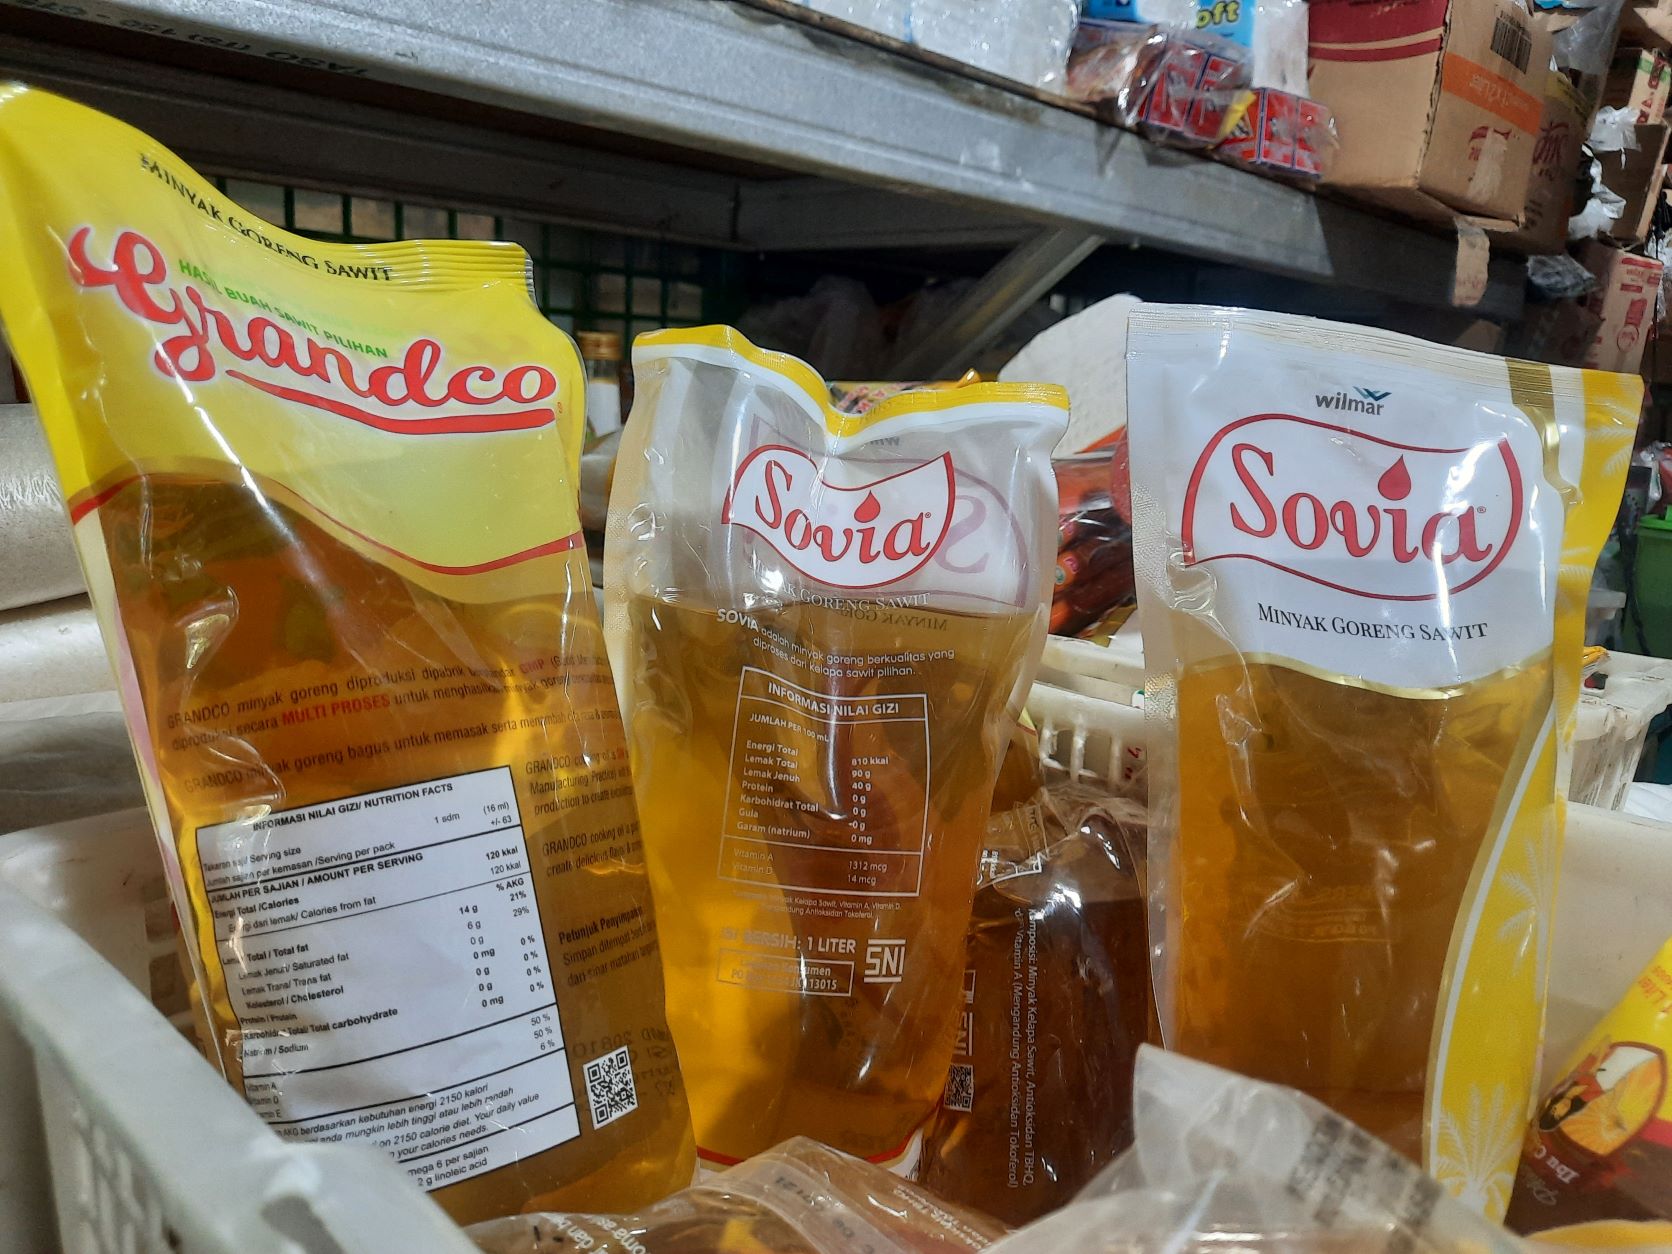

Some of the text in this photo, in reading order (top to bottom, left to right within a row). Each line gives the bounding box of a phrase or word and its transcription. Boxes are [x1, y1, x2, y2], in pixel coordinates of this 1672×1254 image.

[1196, 1, 1239, 28] oft
[140, 153, 394, 281] MINYAK GORENG SAWIT
[67, 227, 557, 406] Grandco
[178, 259, 389, 359] HASIL BUAH SAWIT PILIHAN
[1315, 391, 1384, 416] wilmar
[755, 460, 931, 564] Sovia
[1230, 444, 1493, 564] Sovia
[800, 589, 930, 611] GORENG SAWIT
[1258, 603, 1489, 641] MINYAK GORENG SAWIT
[716, 608, 955, 666] SOVIA adalah minyak goreng berkualitas yang
[753, 637, 916, 679] diproses dari sawit pilihan.
[167, 702, 230, 729] GRANDCO
[237, 692, 282, 715] minyak
[290, 681, 338, 704] goreng
[346, 668, 416, 693] diproduksi
[421, 666, 463, 683] dipabrik
[768, 681, 899, 716] INFORMASI NILAI GIZI
[236, 688, 430, 737] secara MULTI PROSES untuk
[750, 712, 787, 729] JUMLAH
[184, 719, 518, 795] GRANDCO goreng bagus untuk memasak serta
[746, 739, 799, 756] Energi Total
[526, 756, 571, 775] GRANDCO
[745, 753, 799, 769] Lemak Total
[869, 756, 889, 765] kkal
[530, 774, 589, 796] Manufacturing
[743, 767, 801, 784] Lemak Jenuh
[741, 780, 774, 793] Protein
[252, 783, 453, 832] INFORMASI NILAI GIZI/ NUTRITION FACTS
[483, 804, 496, 816] (16
[534, 796, 580, 817] production
[738, 807, 759, 819] Gula
[740, 793, 819, 813] Karbohidrat Total
[442, 813, 460, 824] sdm
[502, 815, 512, 825] 63
[737, 821, 812, 839] Garam (natrium)
[283, 846, 301, 858] size
[485, 845, 518, 861] 120 kkal
[542, 833, 587, 857] GRANDCO
[734, 847, 765, 861] Vitamin
[272, 841, 396, 875] kemasan /Serving per pack
[490, 860, 522, 875] 120 kkal
[575, 849, 609, 870] delicious
[849, 860, 888, 873] 1312 mcg
[242, 852, 424, 898] PER SAJIAN AMOUNT PER SERVING
[506, 877, 525, 890] AKG
[858, 876, 877, 886] mcg
[258, 896, 300, 913] /Calories
[509, 890, 527, 902] 21%
[270, 895, 377, 928] lemak/ Calories from fat
[512, 906, 530, 918] 29%
[805, 906, 843, 918] Antioksidan
[558, 920, 600, 945] Petunjuk
[272, 943, 309, 959] Total fat
[481, 948, 496, 960] mg
[563, 944, 598, 967] Simpan
[599, 933, 631, 954] ditempat
[818, 937, 857, 954] LITER
[1013, 928, 1024, 971] Vitamin
[292, 952, 350, 972] Saturated fat
[864, 946, 906, 977] SNI
[292, 972, 332, 988] Trans fat
[810, 979, 838, 991] 13015
[290, 985, 345, 1004] Cholesterol
[489, 995, 504, 1007] mg
[332, 1007, 399, 1030] carbohydrate
[531, 1015, 542, 1026] 50
[1009, 982, 1023, 1057] (Mengandung
[533, 1029, 544, 1040] 50
[1022, 966, 1038, 1186] Minyak Kelapa Sawit, Antioksidan TBHQ,
[1009, 1059, 1022, 1129] Antioksidan
[300, 1082, 489, 1136] berdasarkan kebutuhan energi 2150 kalori
[345, 1087, 514, 1142] mungkin lebih tinggi atau lebih rendah
[393, 1092, 540, 1146] 2150 calorie Your daily value
[397, 1124, 489, 1159] your calories needs.
[445, 1145, 489, 1168] per sajian
[1007, 1129, 1021, 1189] Tokoferol)
[434, 1157, 488, 1182] linoleic acid
